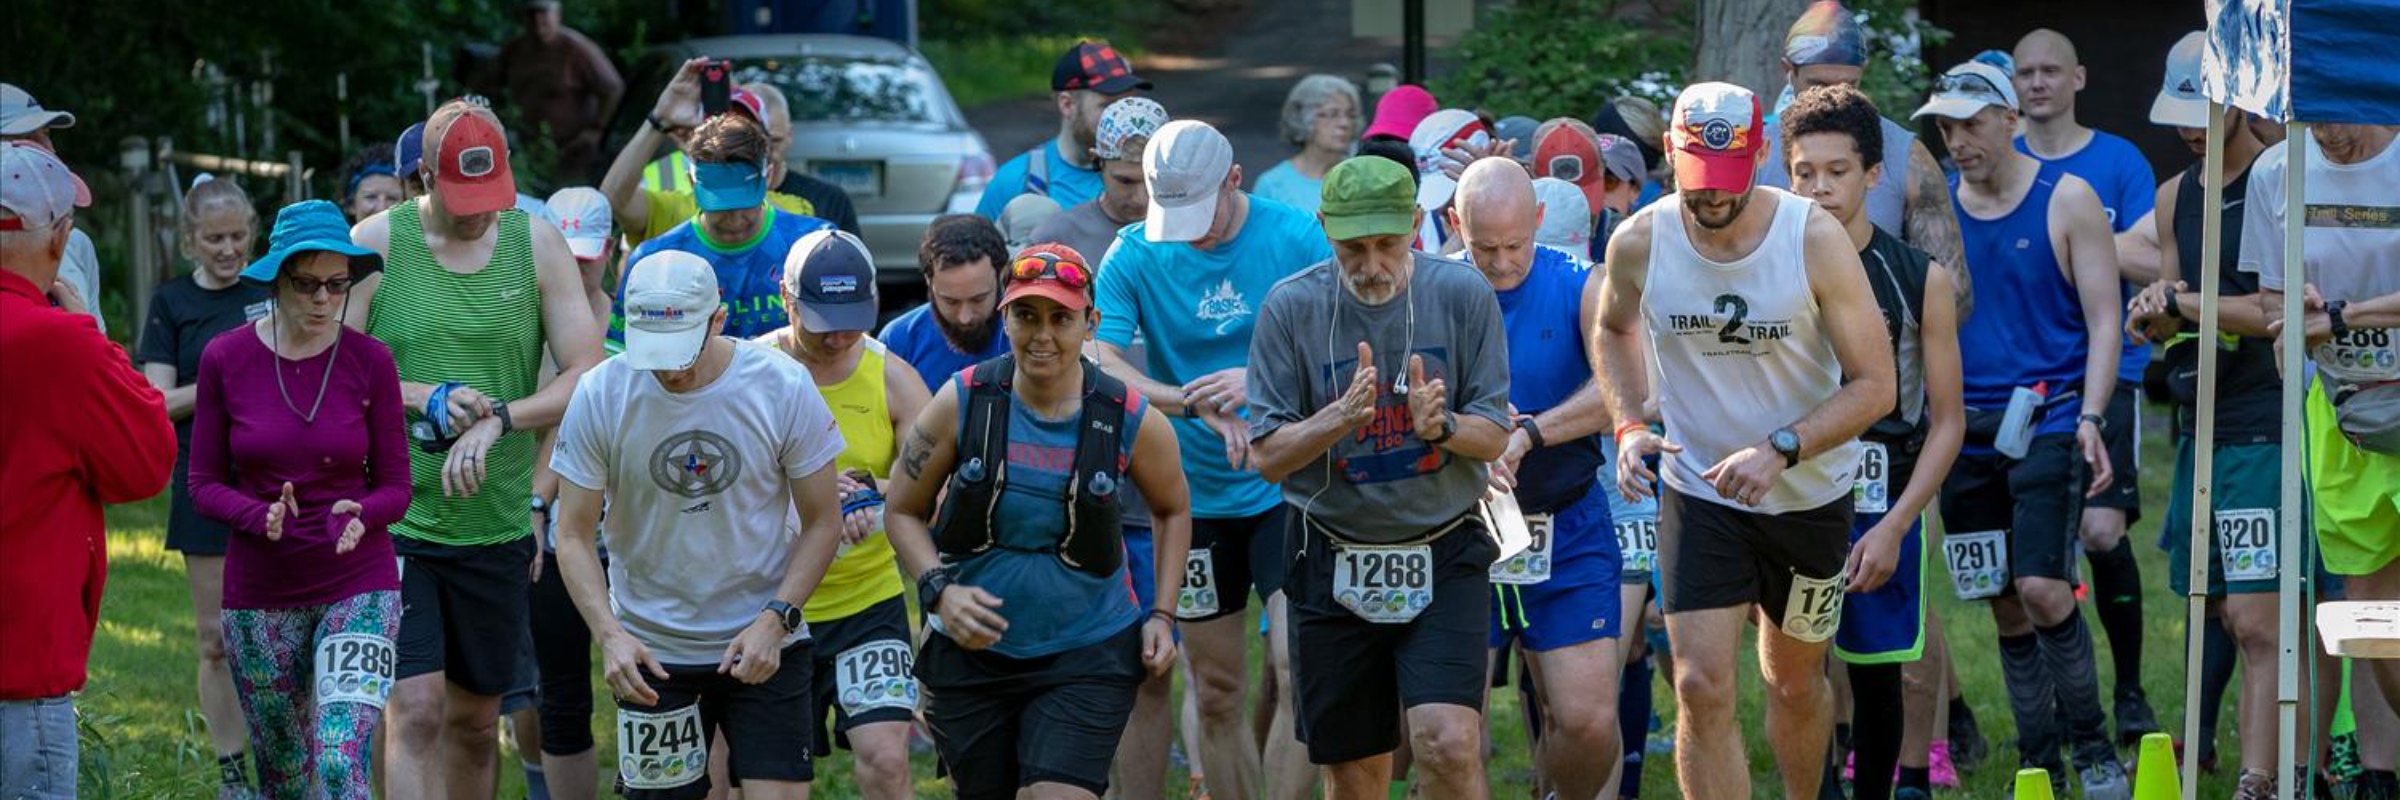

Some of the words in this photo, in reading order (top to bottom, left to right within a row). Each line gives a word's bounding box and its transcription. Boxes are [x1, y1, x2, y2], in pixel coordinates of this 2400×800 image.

[1668, 314, 1716, 330] TRAIL
[1713, 294, 1751, 344] 2
[1747, 324, 1792, 340] TRAIL
[1376, 433, 1404, 452] 100
[2216, 517, 2269, 550] 320
[1182, 558, 1208, 589] 3
[1345, 552, 1427, 590] 1268
[1946, 539, 1998, 572] 1291
[324, 640, 393, 679] 1289
[844, 647, 914, 687] 1296
[623, 715, 700, 756] 1244
